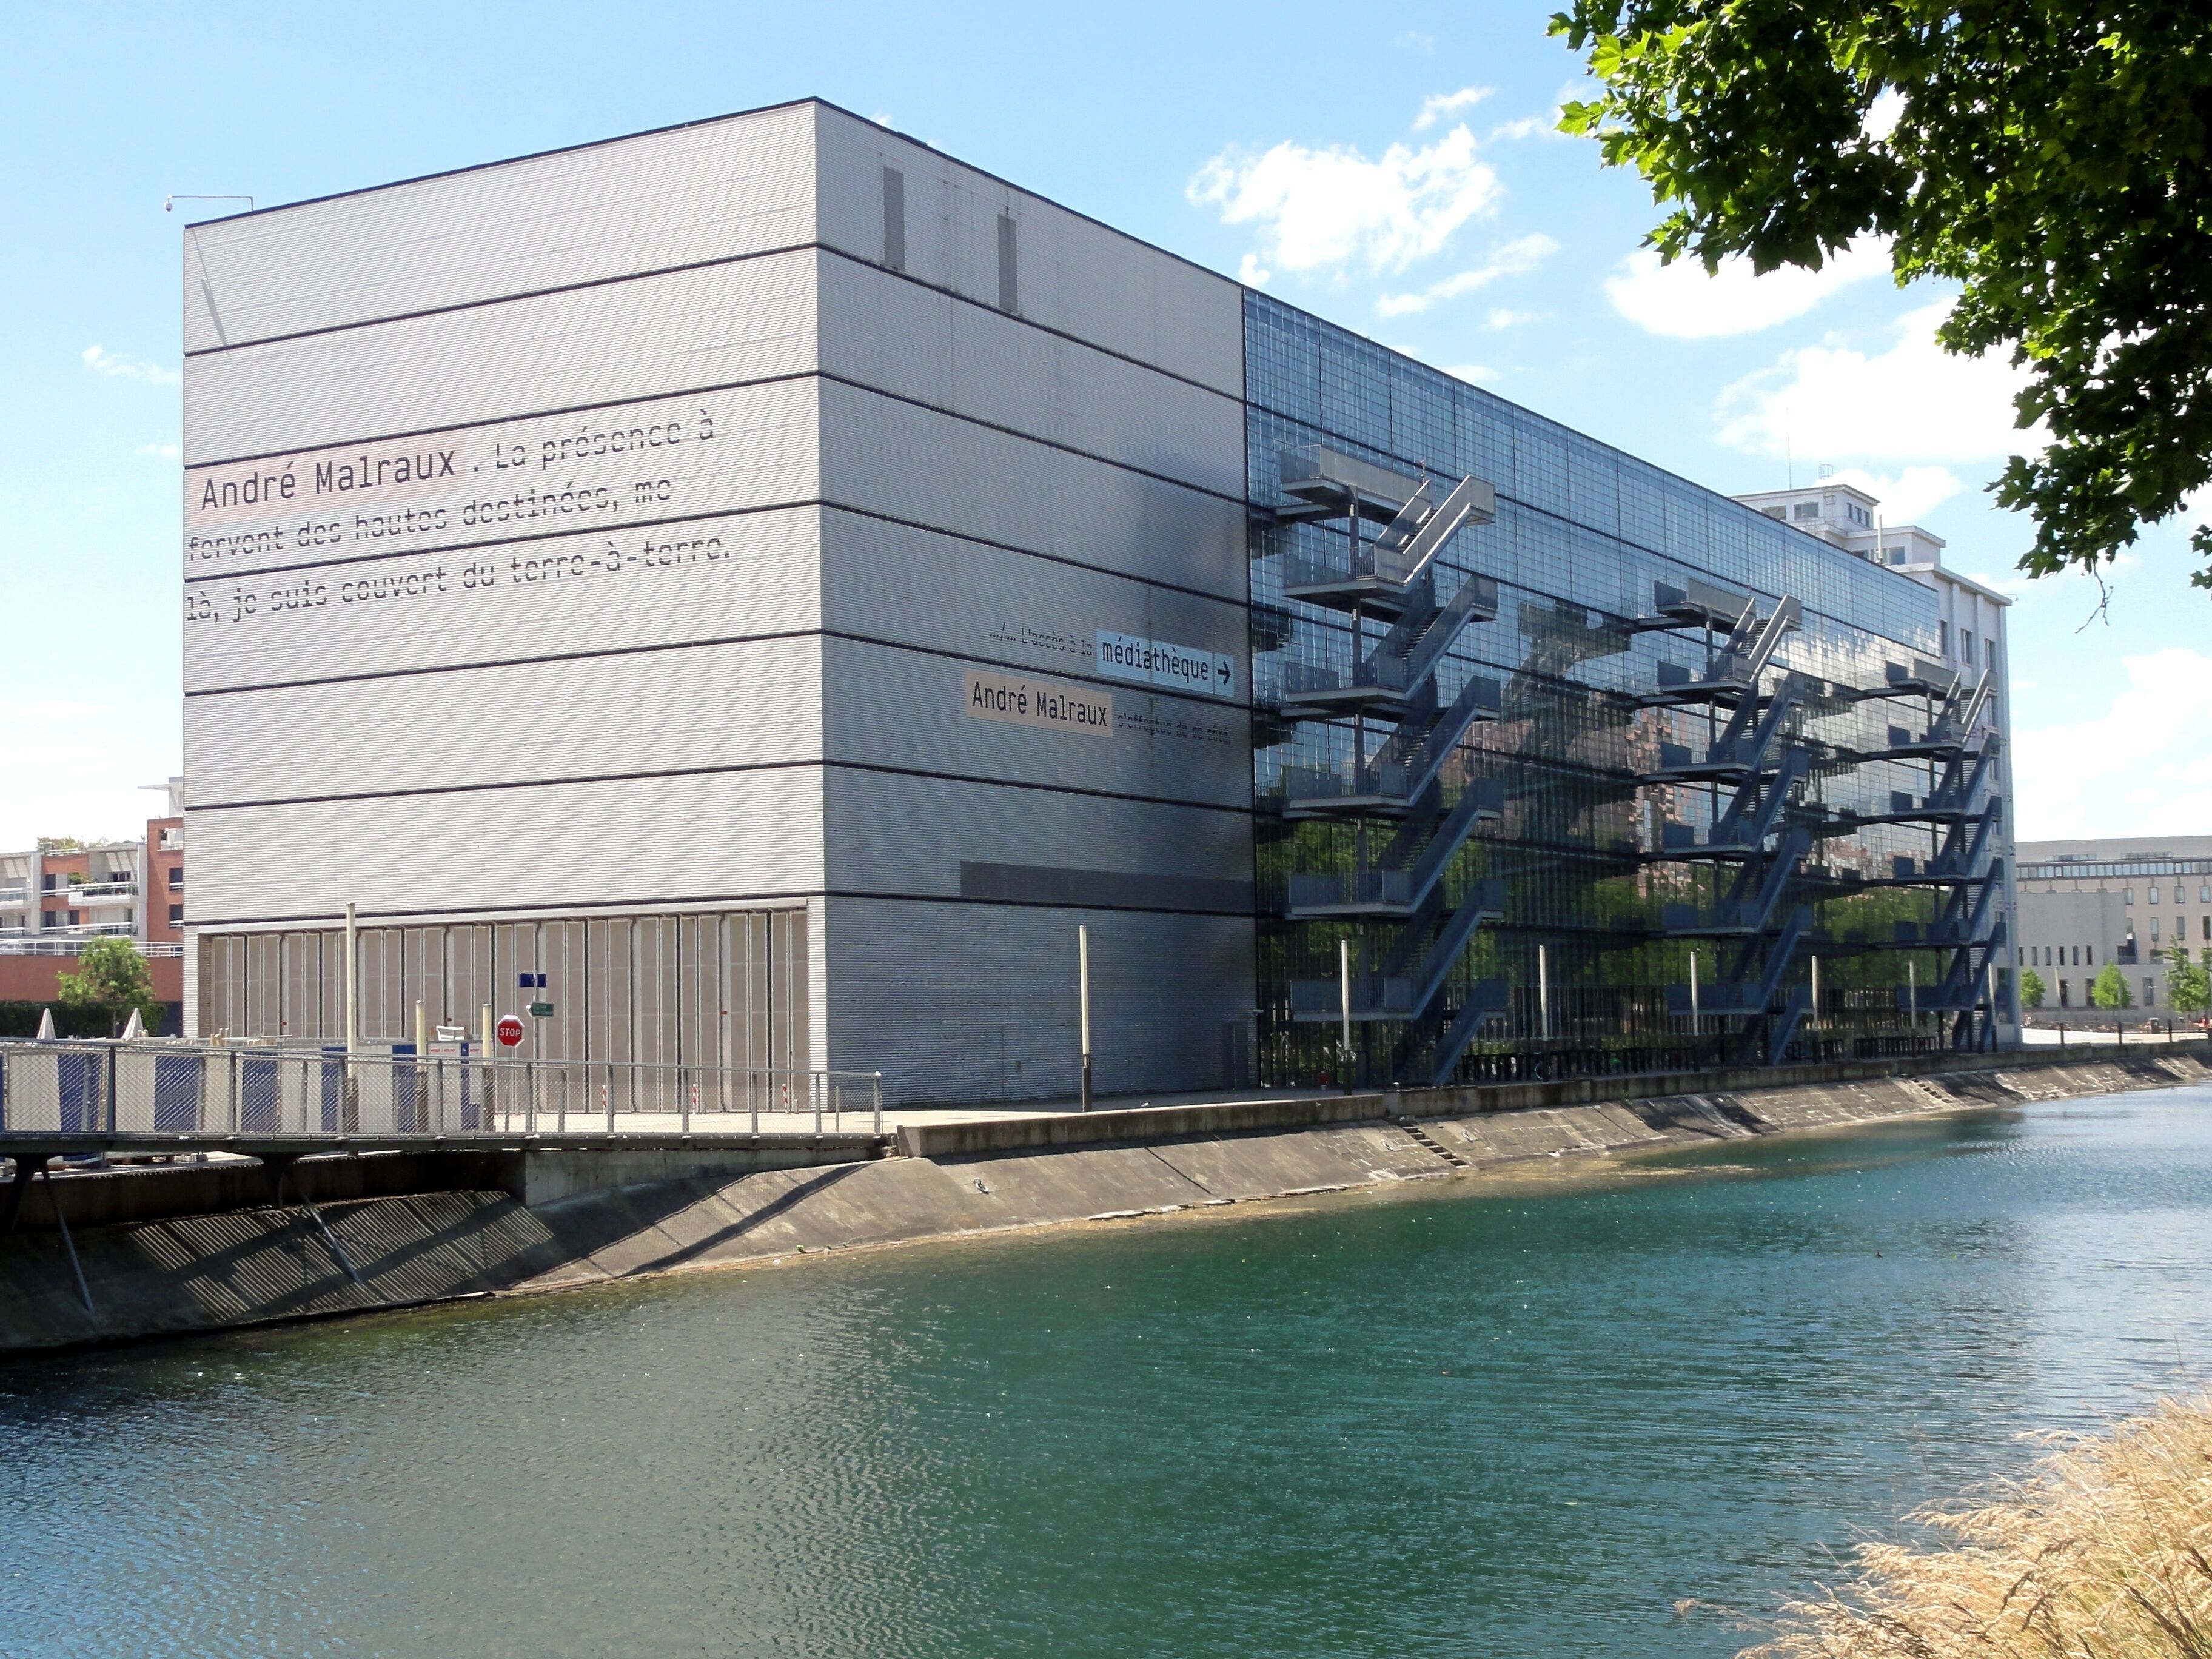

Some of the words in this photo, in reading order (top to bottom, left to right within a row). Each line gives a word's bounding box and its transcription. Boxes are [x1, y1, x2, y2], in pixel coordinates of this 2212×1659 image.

[201, 460, 296, 511] André
[315, 450, 456, 495] Malraux
[496, 444, 526, 469] La
[542, 423, 681, 471] présence
[699, 409, 714, 440] à
[187, 526, 284, 561] fervent
[298, 521, 342, 548] des
[355, 508, 447, 540] hautes
[463, 481, 618, 526] destinées,
[635, 479, 671, 504] me
[232, 588, 257, 623] je
[270, 580, 327, 612] suis
[341, 566, 447, 603] couvert
[463, 562, 495, 589] du
[1102, 636, 1210, 684] médiathèque
[972, 680, 1028, 715] André
[1036, 690, 1108, 727] Malraux
[500, 1028, 521, 1037] STOP
